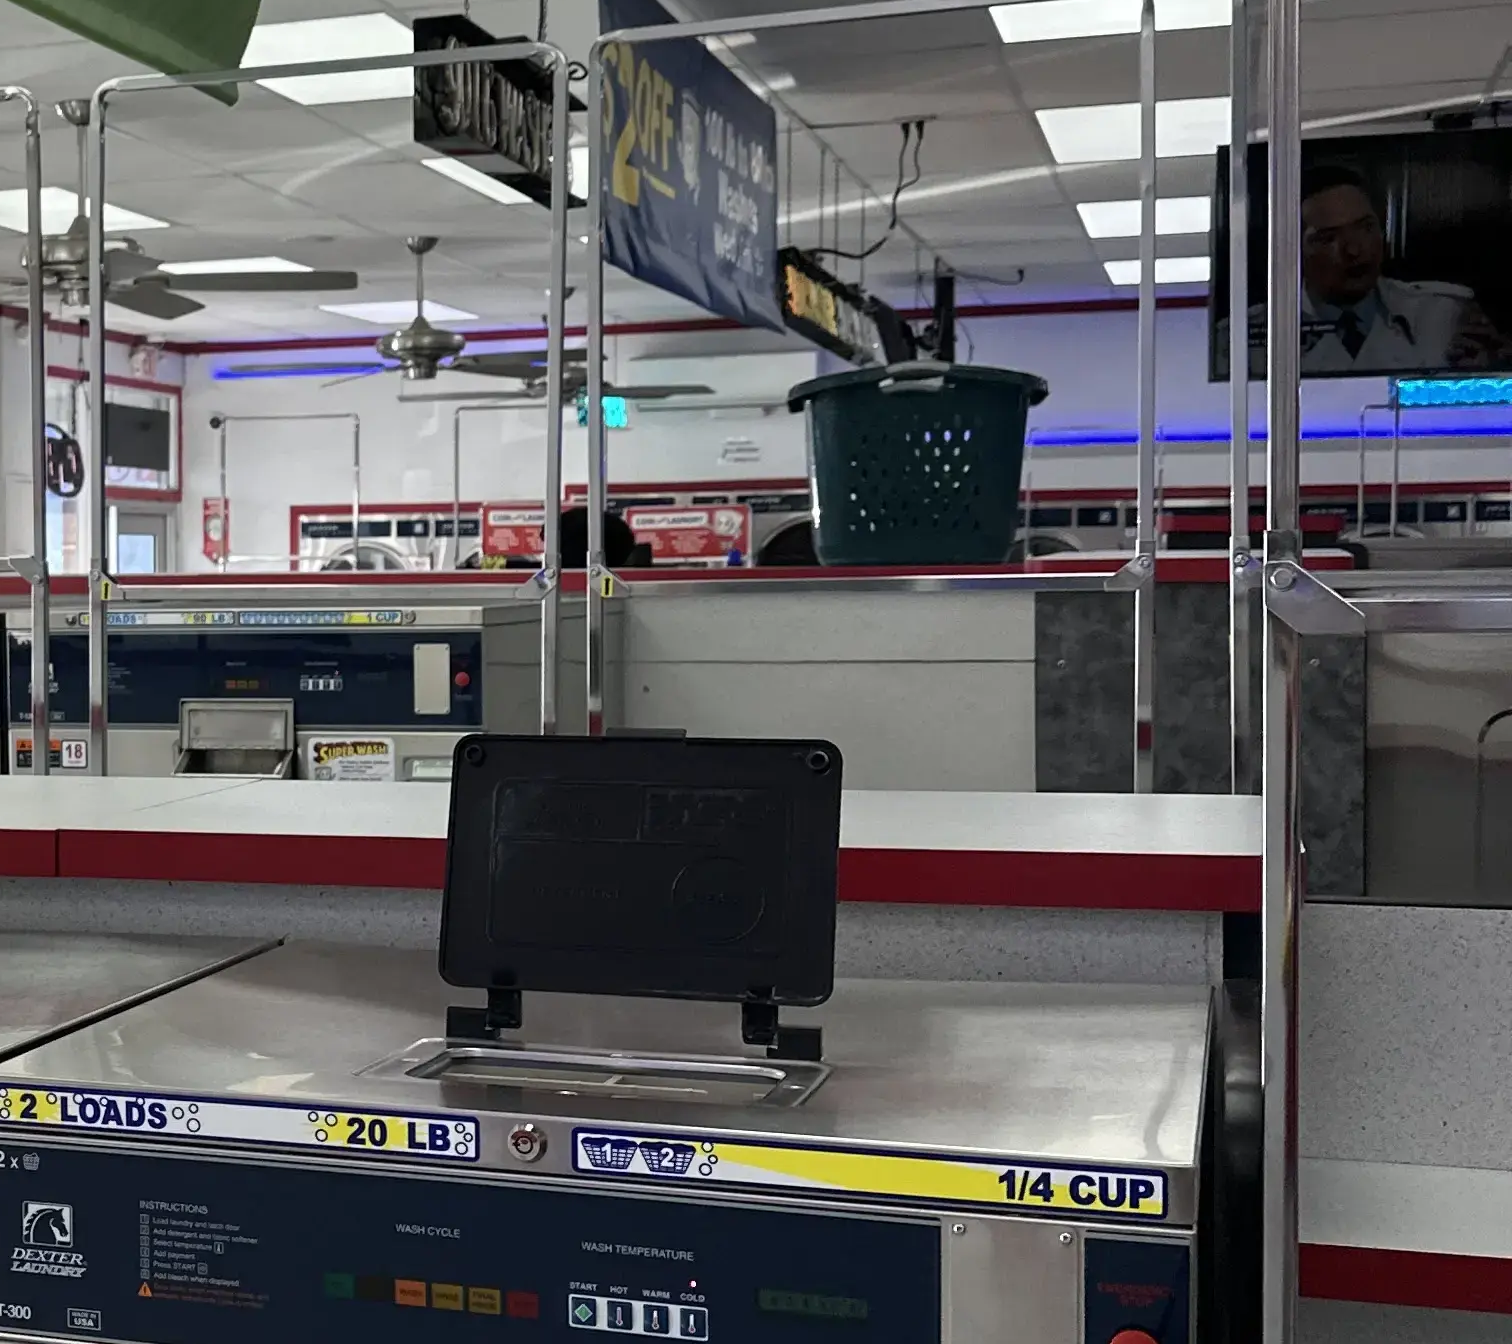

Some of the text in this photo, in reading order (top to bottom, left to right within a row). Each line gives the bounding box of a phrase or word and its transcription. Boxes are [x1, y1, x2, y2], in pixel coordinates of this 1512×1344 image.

[638, 57, 674, 171] OFF
[65, 743, 83, 759] 18
[18, 1092, 451, 1153] 2 LOADS 20 LB
[9, 1156, 20, 1170] x
[998, 1169, 1156, 1210] 1/4 CUP
[139, 1199, 209, 1215] INSTRUCTIONS
[395, 1222, 461, 1239] WASH CYCLE
[11, 1247, 85, 1267] DEXTER
[581, 1241, 695, 1262] WASH TEMPERATURE
[10, 1260, 88, 1279] LAUNDRY
[569, 1281, 706, 1303] START HOT WARM COLD
[73, 1317, 95, 1327] USA
